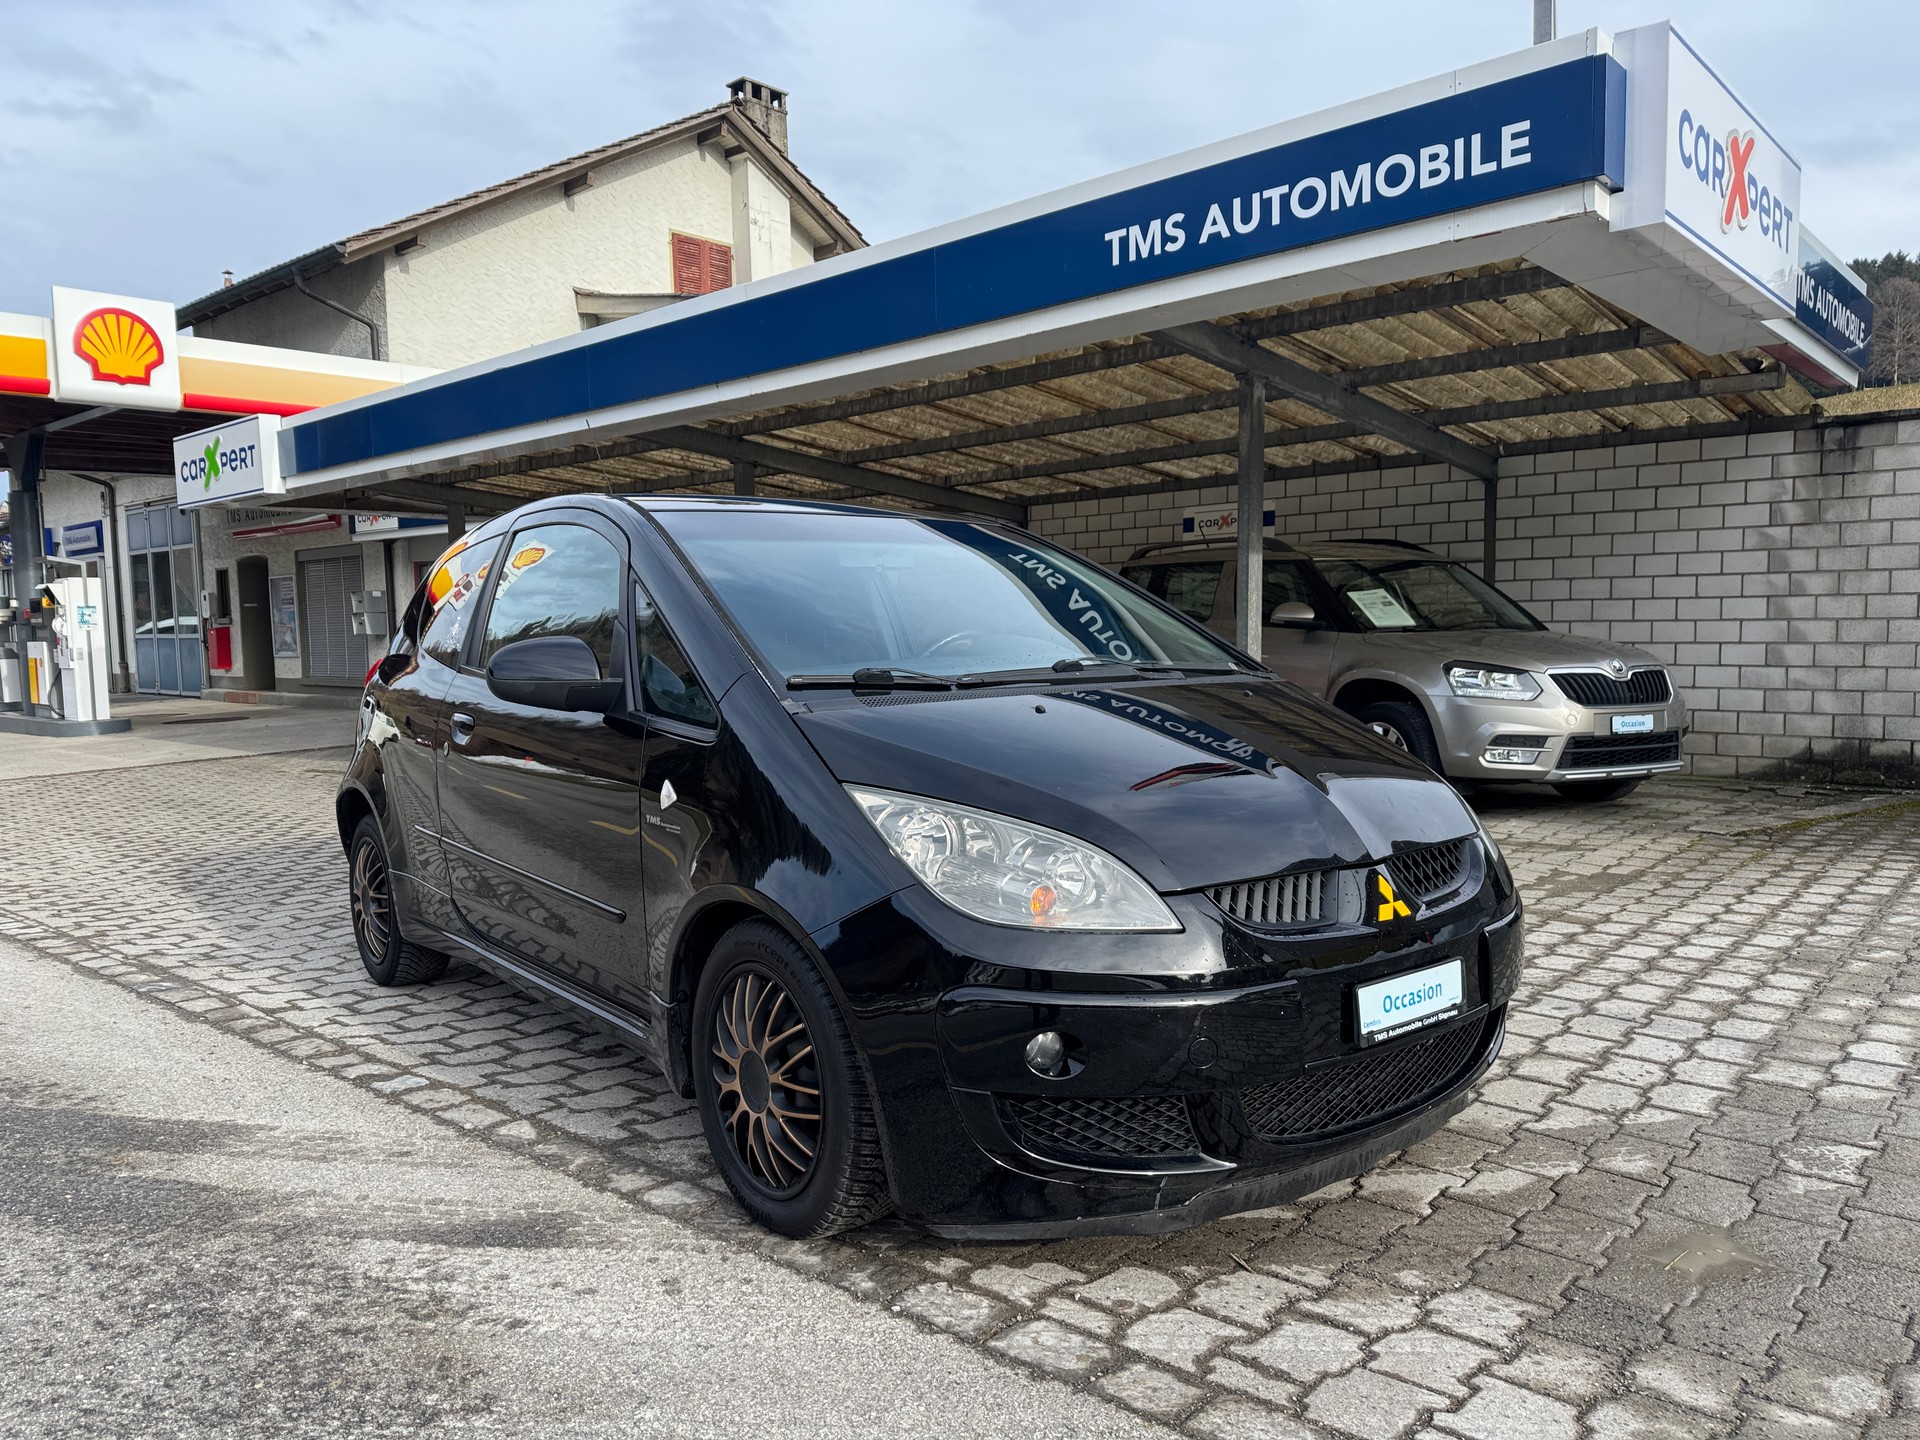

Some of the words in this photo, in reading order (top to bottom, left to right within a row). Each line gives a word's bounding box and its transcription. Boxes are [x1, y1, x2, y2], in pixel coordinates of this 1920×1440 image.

[1104, 212, 1186, 267] TMS
[1198, 119, 1532, 245] AUTOMOBILE
[1797, 269, 1815, 309] TMS
[1815, 285, 1866, 349] AUTOMOBILE
[226, 509, 241, 524] TMS
[1621, 719, 1646, 728] Occasion
[645, 814, 661, 826] TMS
[734, 940, 756, 949] Winter
[1383, 982, 1443, 1013] Occasion
[1373, 1031, 1388, 1042] TMS
[1388, 1021, 1423, 1038] Automobile
[1423, 1015, 1438, 1026] GmbH
[1438, 1009, 1458, 1022] Signau
